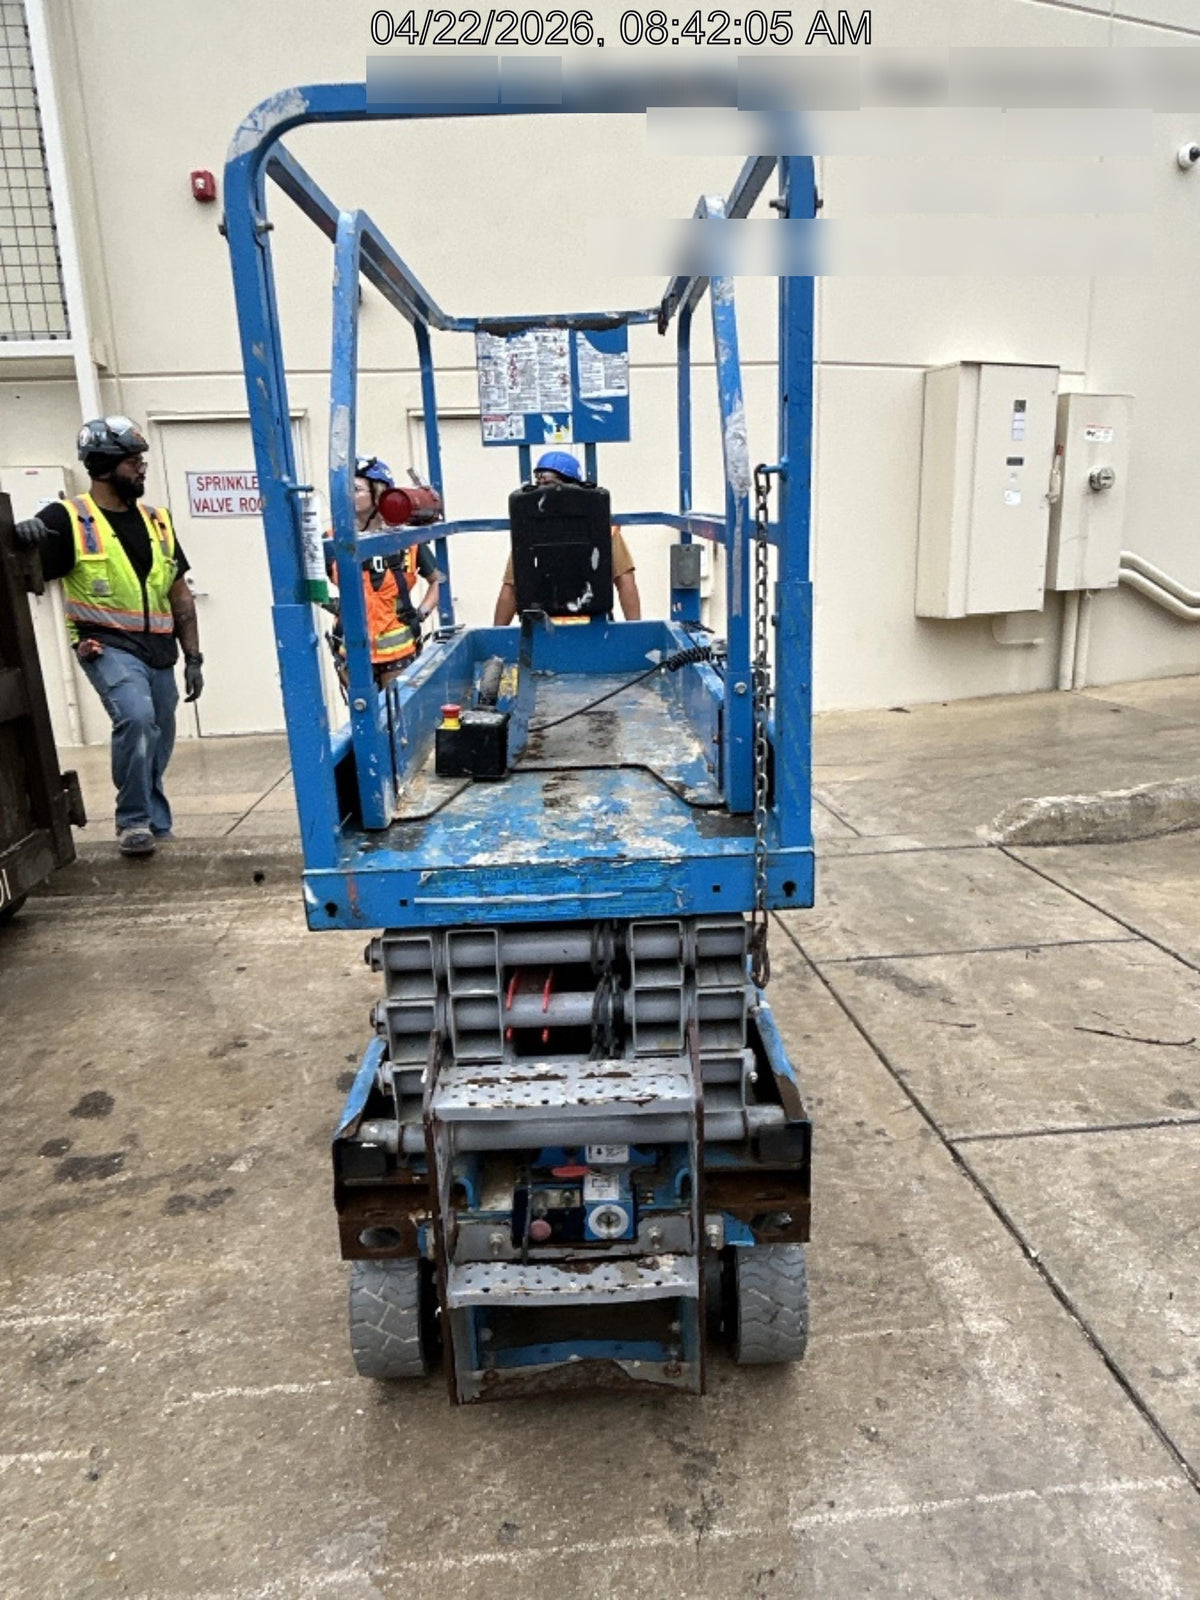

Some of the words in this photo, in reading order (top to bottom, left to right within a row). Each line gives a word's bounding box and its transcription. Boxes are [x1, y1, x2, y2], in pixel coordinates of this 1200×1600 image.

[197, 475, 259, 491] SPRINKLE
[194, 497, 234, 512] VALVE
[240, 496, 264, 512] ROO
